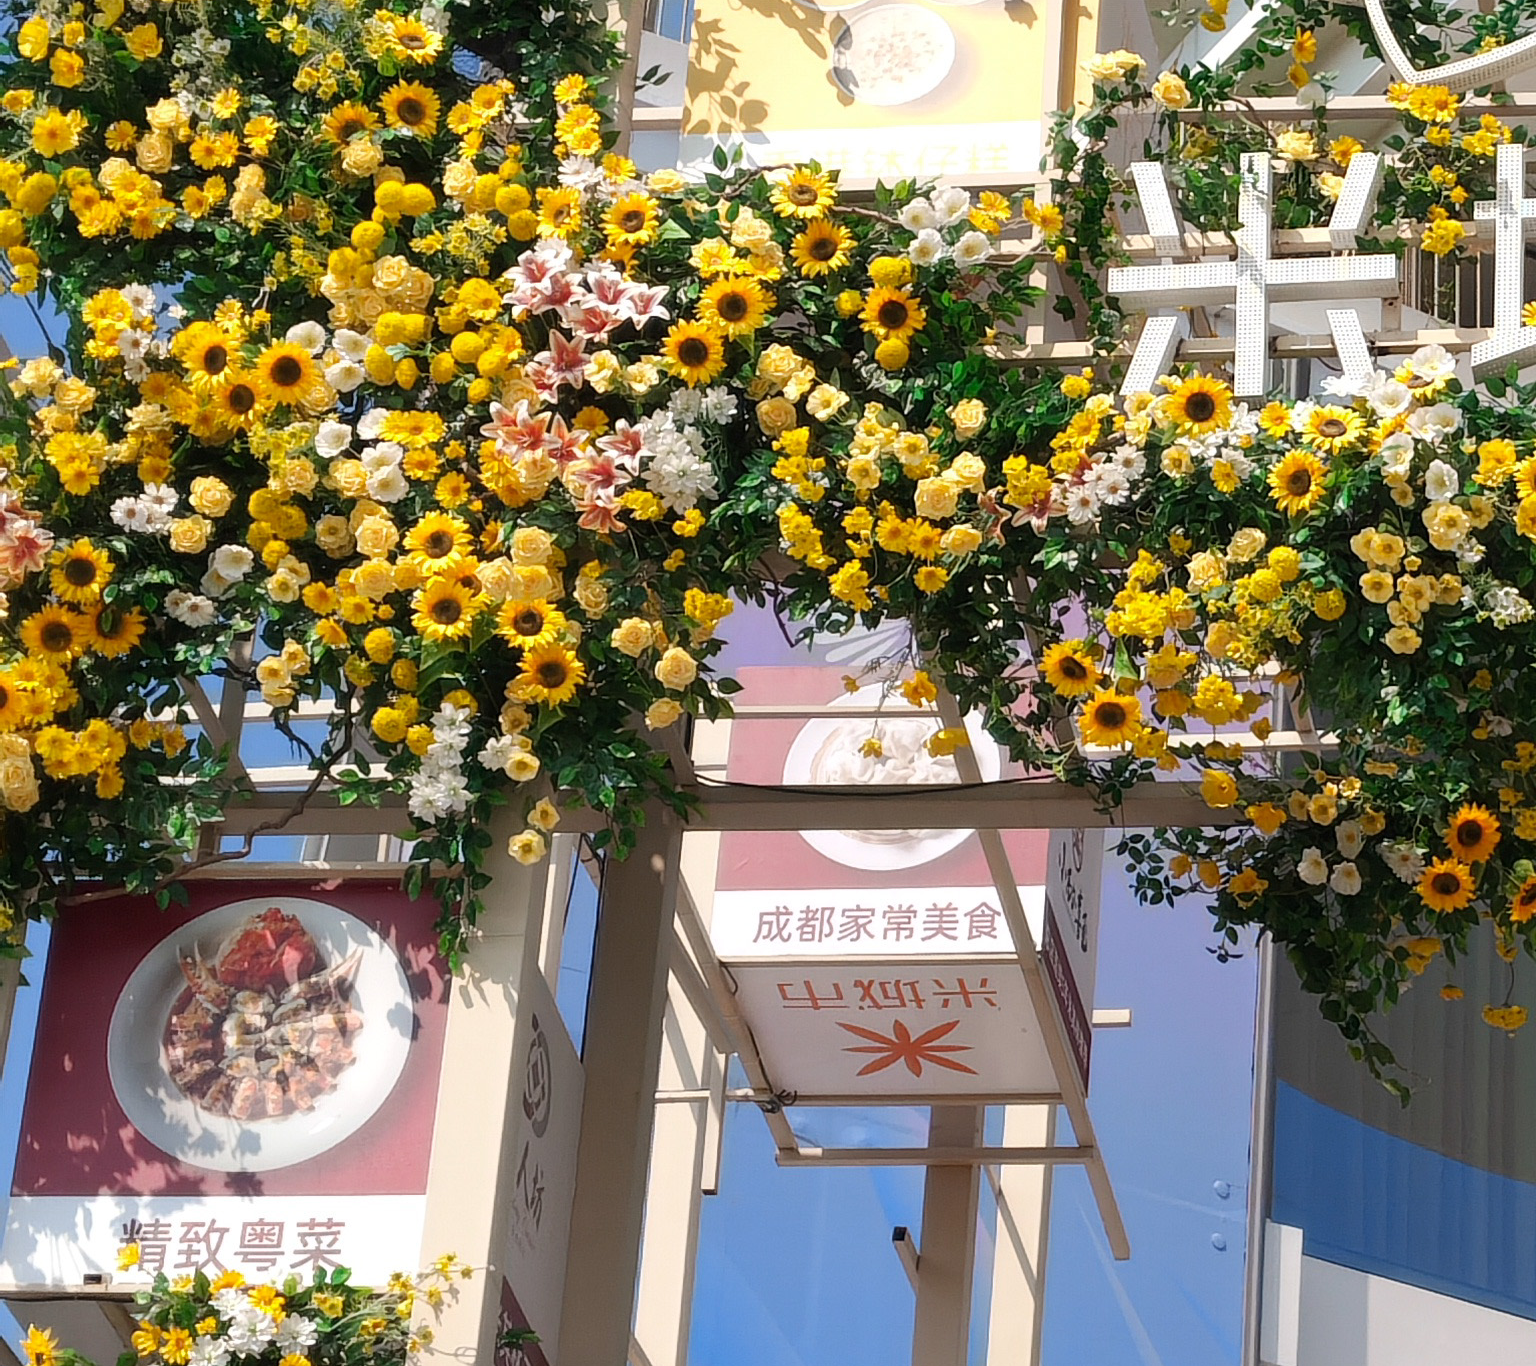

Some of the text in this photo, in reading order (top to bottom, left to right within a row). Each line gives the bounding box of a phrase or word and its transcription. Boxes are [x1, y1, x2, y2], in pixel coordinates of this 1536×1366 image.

[752, 901, 1002, 944] 成都家常美食
[119, 1217, 346, 1276] 精致粤菜
